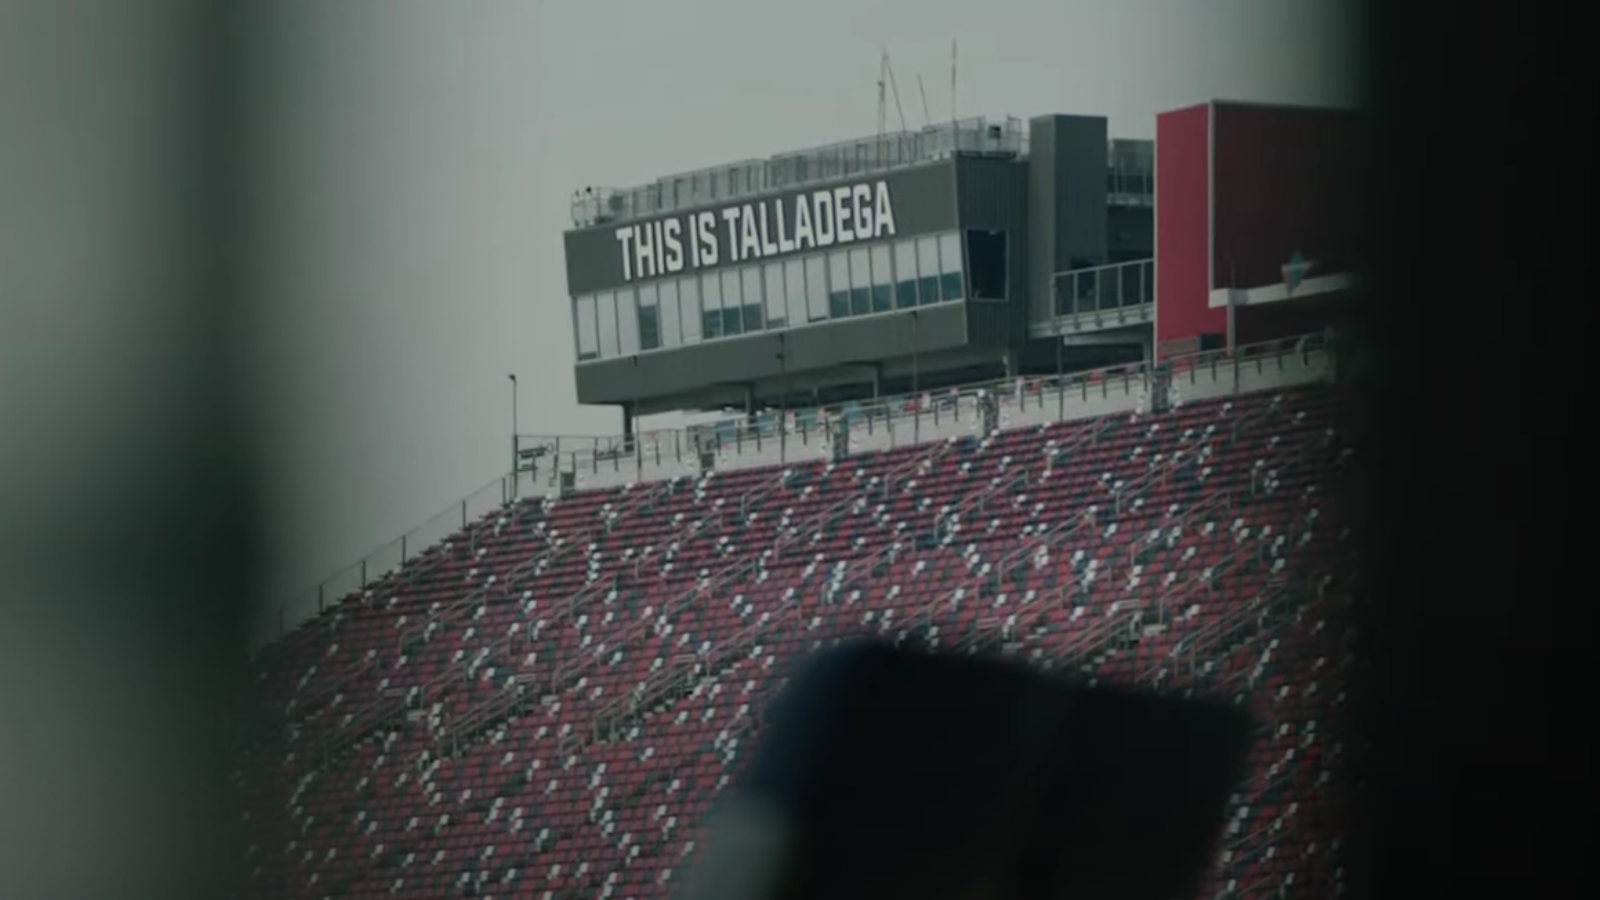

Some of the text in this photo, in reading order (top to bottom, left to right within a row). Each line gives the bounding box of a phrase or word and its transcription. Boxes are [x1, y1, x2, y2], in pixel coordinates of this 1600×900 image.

[616, 181, 896, 280] THIS IS TALLADEGA
